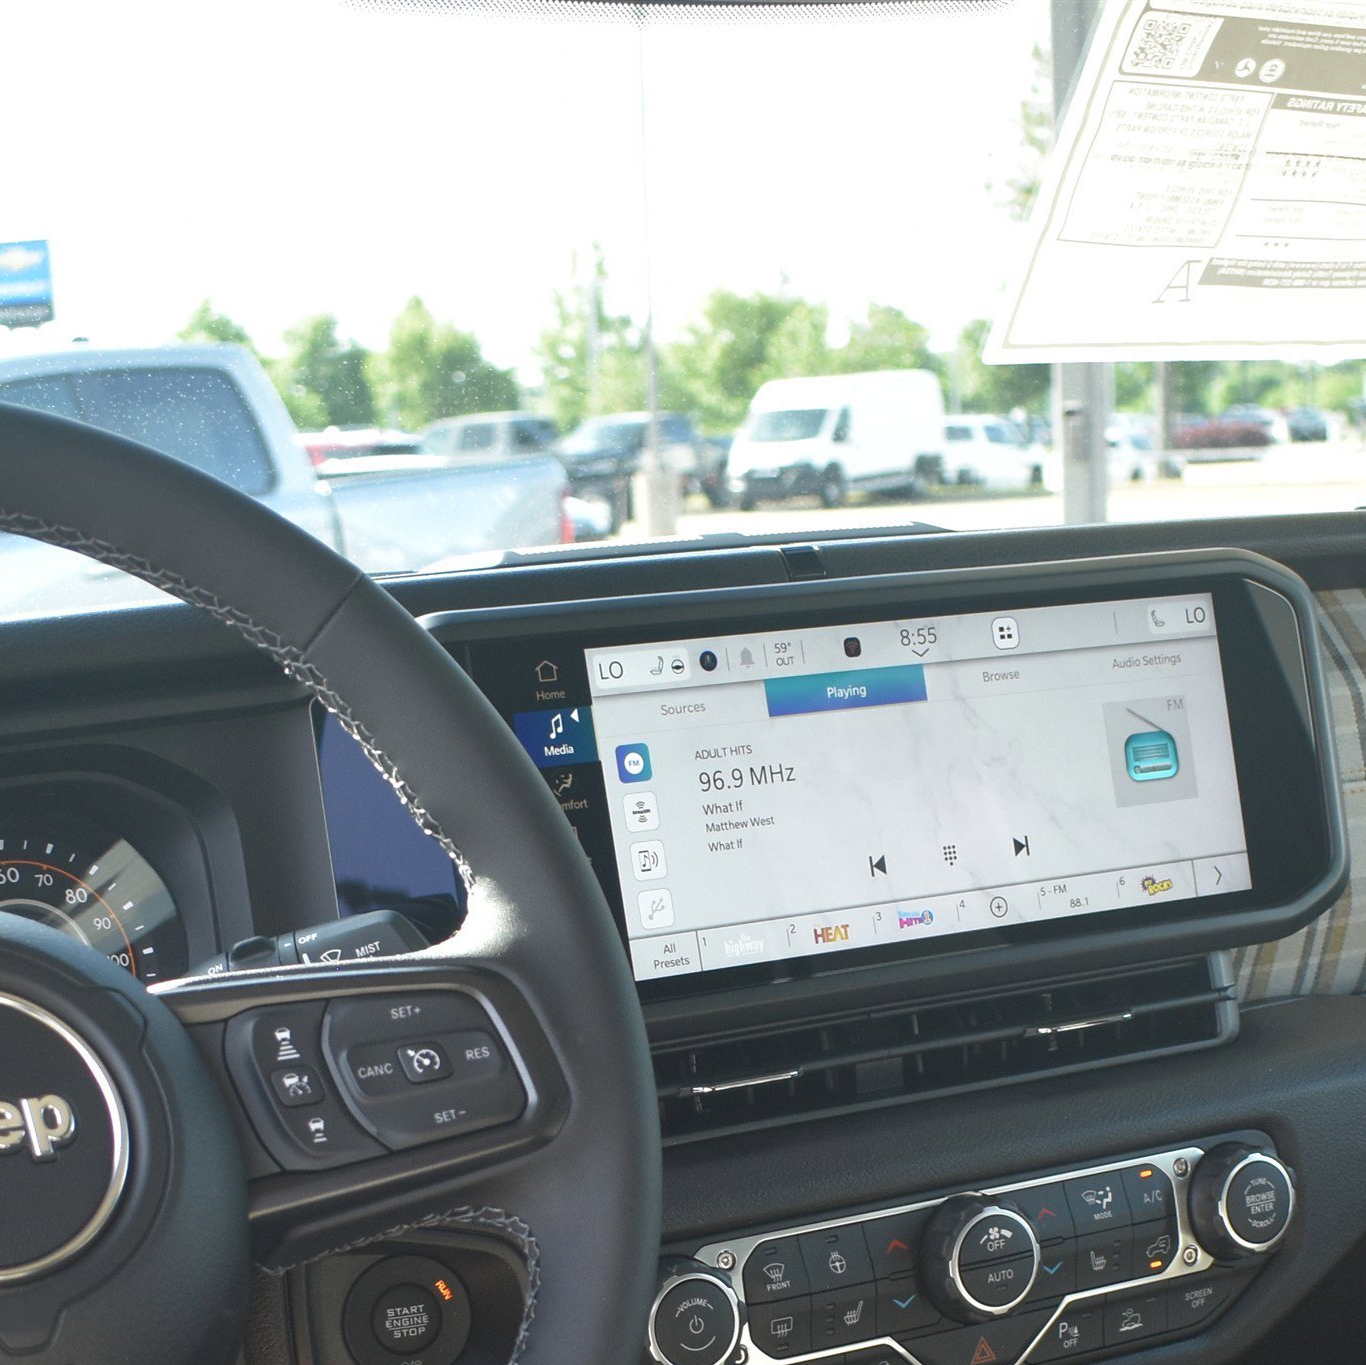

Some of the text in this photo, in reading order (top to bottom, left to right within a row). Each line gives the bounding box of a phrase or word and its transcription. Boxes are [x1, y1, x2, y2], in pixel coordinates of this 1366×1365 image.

[1186, 607, 1206, 624] LO
[899, 627, 938, 646] 8:55
[774, 642, 792, 654] 59°
[776, 656, 794, 667] OUT
[1112, 652, 1182, 669] Audio Settings
[599, 661, 624, 680] LO
[982, 668, 1020, 682] Browse
[536, 689, 566, 701] Home
[827, 684, 867, 699] Playing
[660, 702, 706, 716] Sources
[1166, 699, 1184, 711] FM
[544, 744, 574, 756] Media
[695, 745, 752, 760] ADULT HITS
[699, 764, 796, 792] 96.9 MHz
[702, 800, 744, 816] What If
[706, 816, 775, 833] Matthew West
[708, 839, 744, 853] What If
[35, 874, 53, 887] 70
[1119, 877, 1126, 886] 6
[65, 888, 87, 904] 80
[1040, 884, 1067, 896] 5 FM
[959, 900, 966, 909] 4
[1069, 897, 1089, 908] 88.1
[876, 912, 882, 921] 3
[93, 917, 111, 930] 90
[790, 924, 796, 934] 2
[298, 933, 318, 944] OFF
[813, 924, 850, 944] HEAT
[663, 943, 676, 954] All
[702, 937, 707, 947] 1
[355, 941, 381, 958] MIST
[653, 956, 690, 970] Presets
[207, 964, 223, 976] ON
[390, 1005, 422, 1020] SET+
[466, 1047, 490, 1060] RES
[358, 1063, 393, 1079] CANC
[1250, 1177, 1267, 1186] TUNE
[1143, 1191, 1163, 1203] A/C
[1245, 1190, 1276, 1204] BROWSE
[1250, 1202, 1275, 1214] ENTER
[1093, 1211, 1113, 1220] MODE
[1251, 1216, 1275, 1228] SCROLL
[987, 1240, 1006, 1252] OFF
[987, 1269, 1014, 1284] AUTO
[435, 1279, 453, 1301] RUN
[766, 1281, 791, 1291] FRONT
[1185, 1287, 1213, 1301] SCREEN
[677, 1298, 708, 1313] VOLUME
[1191, 1298, 1206, 1308] OFF
[386, 1304, 425, 1317] START
[385, 1315, 429, 1328] ENGINE
[393, 1326, 426, 1338] STOP
[1063, 1338, 1079, 1348] OFF
